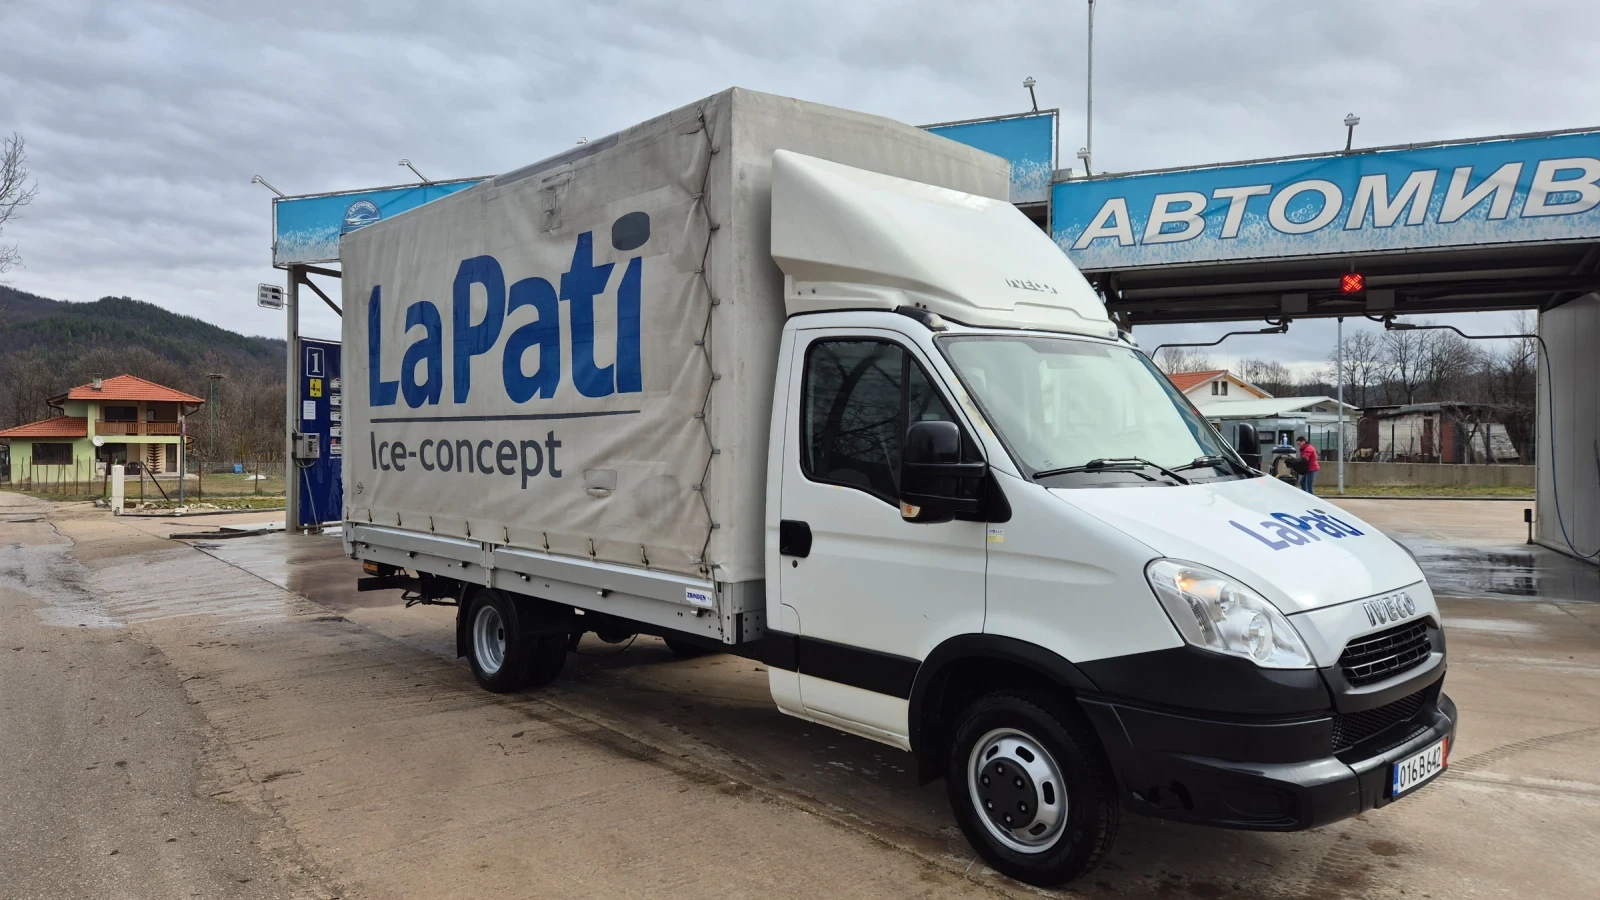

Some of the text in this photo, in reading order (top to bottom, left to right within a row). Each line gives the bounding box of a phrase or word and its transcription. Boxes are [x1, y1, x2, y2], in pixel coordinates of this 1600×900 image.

[1069, 156, 1600, 250] АВТОМИВ
[311, 352, 321, 373] 1
[369, 430, 562, 490] Ice-concept
[686, 591, 707, 601] ZBINDEN
[1362, 591, 1415, 628] IVECO
